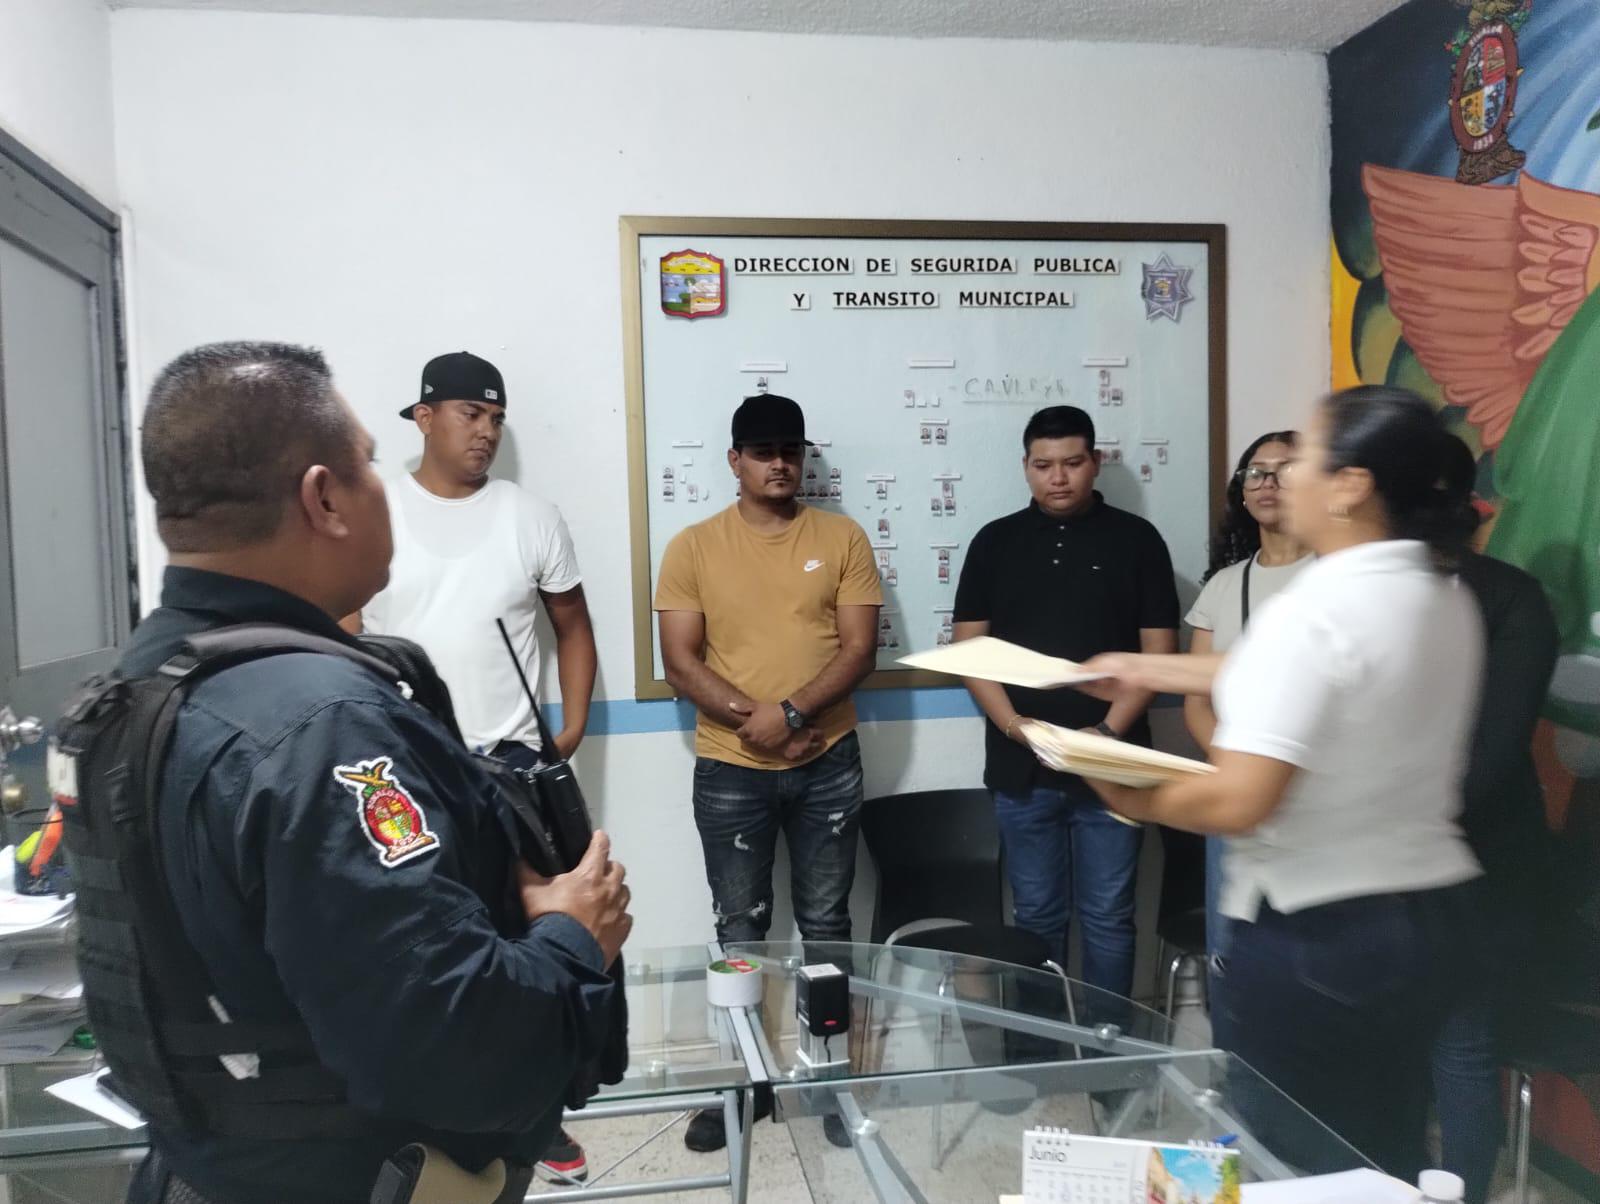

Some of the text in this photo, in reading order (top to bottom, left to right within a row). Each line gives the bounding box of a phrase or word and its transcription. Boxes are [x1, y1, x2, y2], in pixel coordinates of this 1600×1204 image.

[733, 257, 1117, 273] DIRECCION DE SEGURIDA PUBLICA
[792, 291, 1070, 308] Y TRANSITO MUNICIPAL
[1028, 1146, 1067, 1163] Junio
